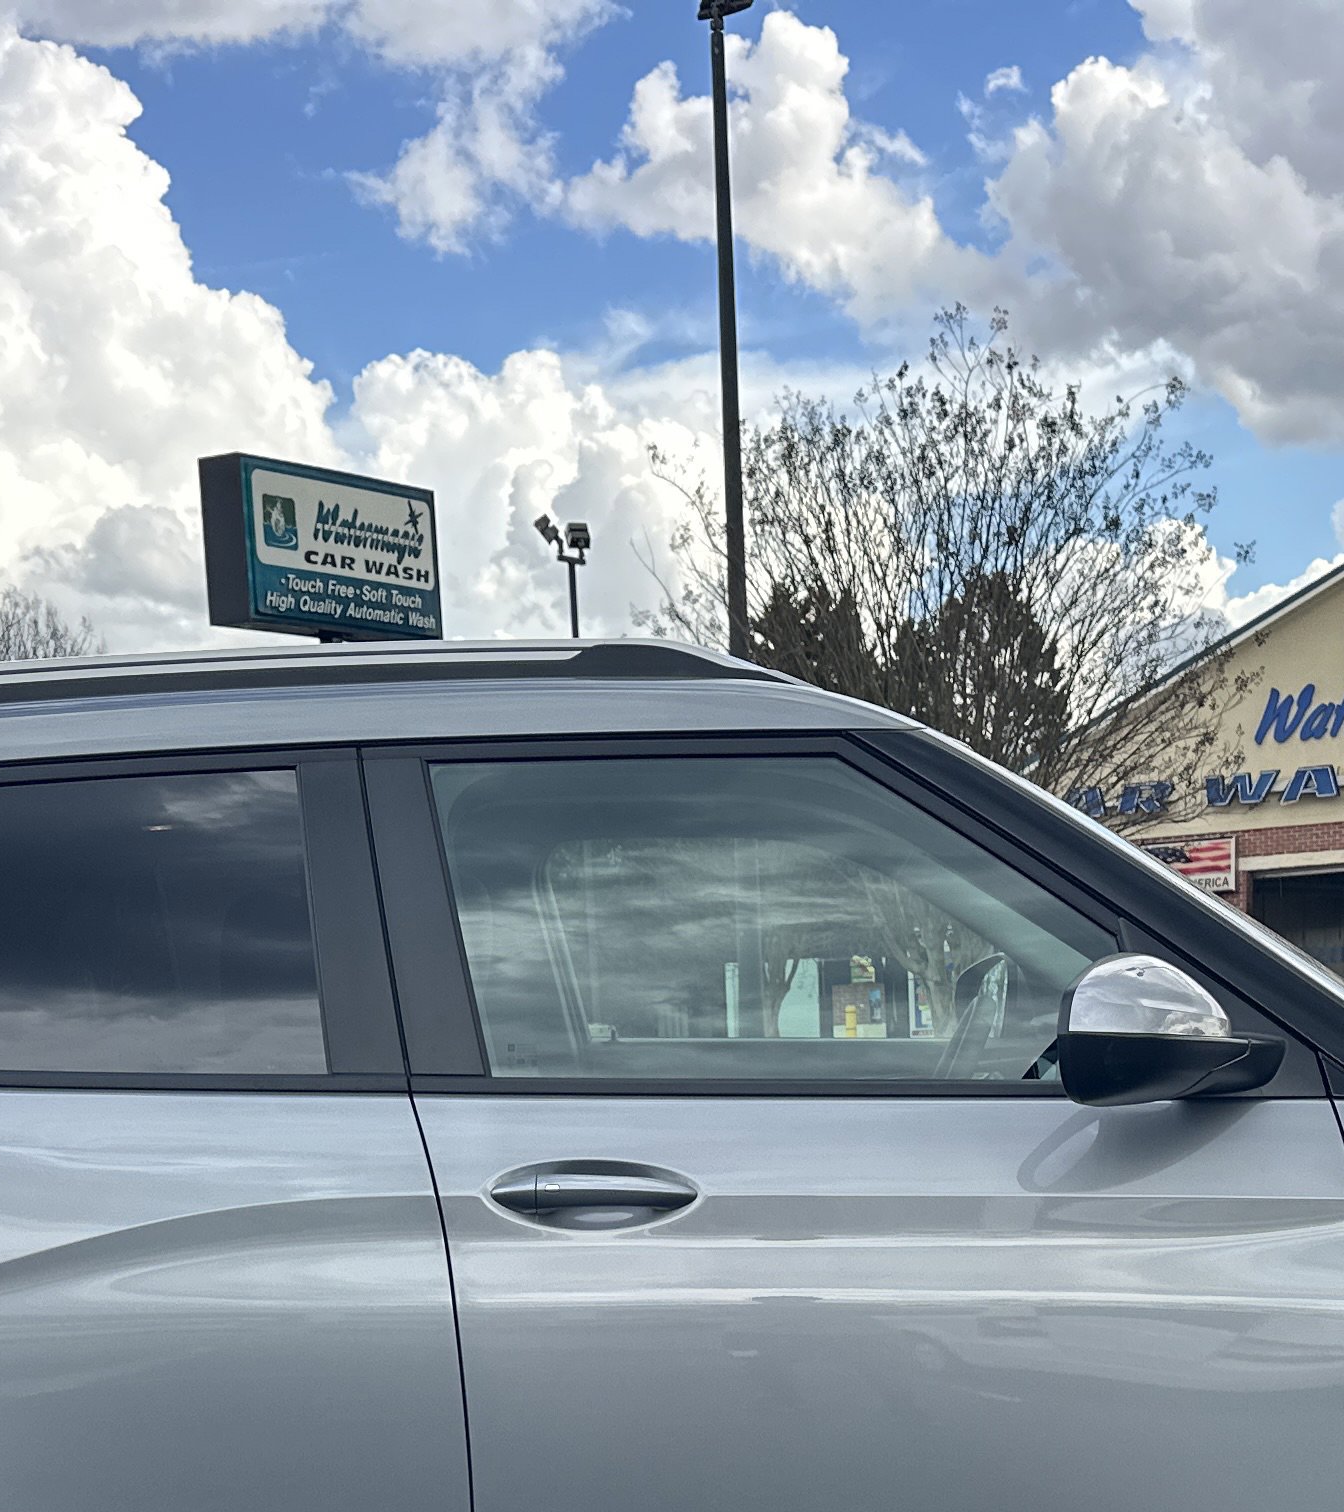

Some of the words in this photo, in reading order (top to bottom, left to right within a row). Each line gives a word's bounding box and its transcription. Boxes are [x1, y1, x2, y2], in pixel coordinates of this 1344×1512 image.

[313, 500, 424, 565] Watermagic
[304, 550, 355, 570] CAR
[364, 559, 429, 583] WASH
[286, 574, 323, 594] Touch
[328, 581, 354, 598] Free
[362, 585, 386, 603] Soft
[391, 590, 422, 608] Touch
[266, 591, 295, 611] High
[300, 596, 343, 618] Quality
[346, 602, 404, 625] Automatic
[408, 611, 436, 629] Wash
[1067, 780, 1175, 817] AR
[1194, 877, 1230, 889] ERICA
